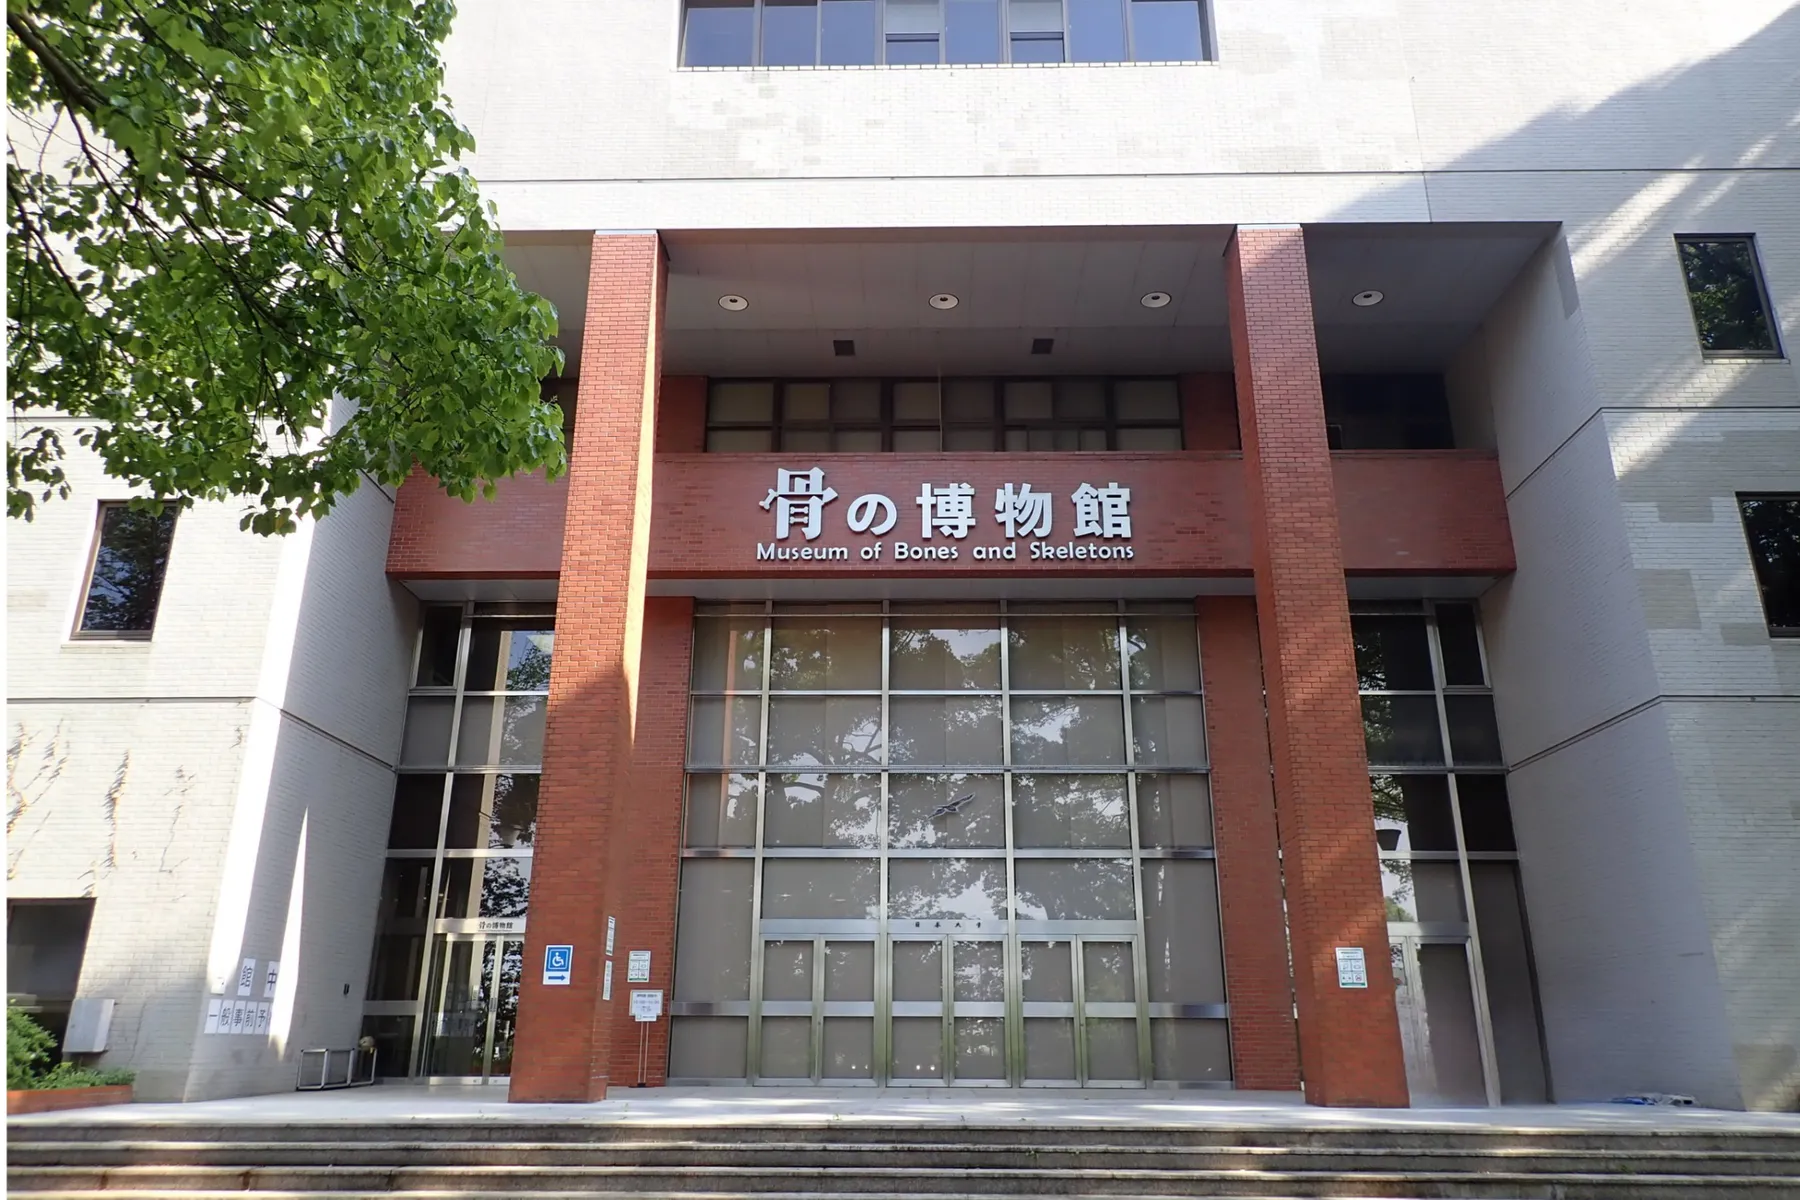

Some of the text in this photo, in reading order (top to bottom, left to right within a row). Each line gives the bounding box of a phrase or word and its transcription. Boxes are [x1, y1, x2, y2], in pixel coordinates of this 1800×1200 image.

[759, 467, 1132, 540] 骨の博物館
[756, 541, 1134, 560] Museum of Bones and Skeletons
